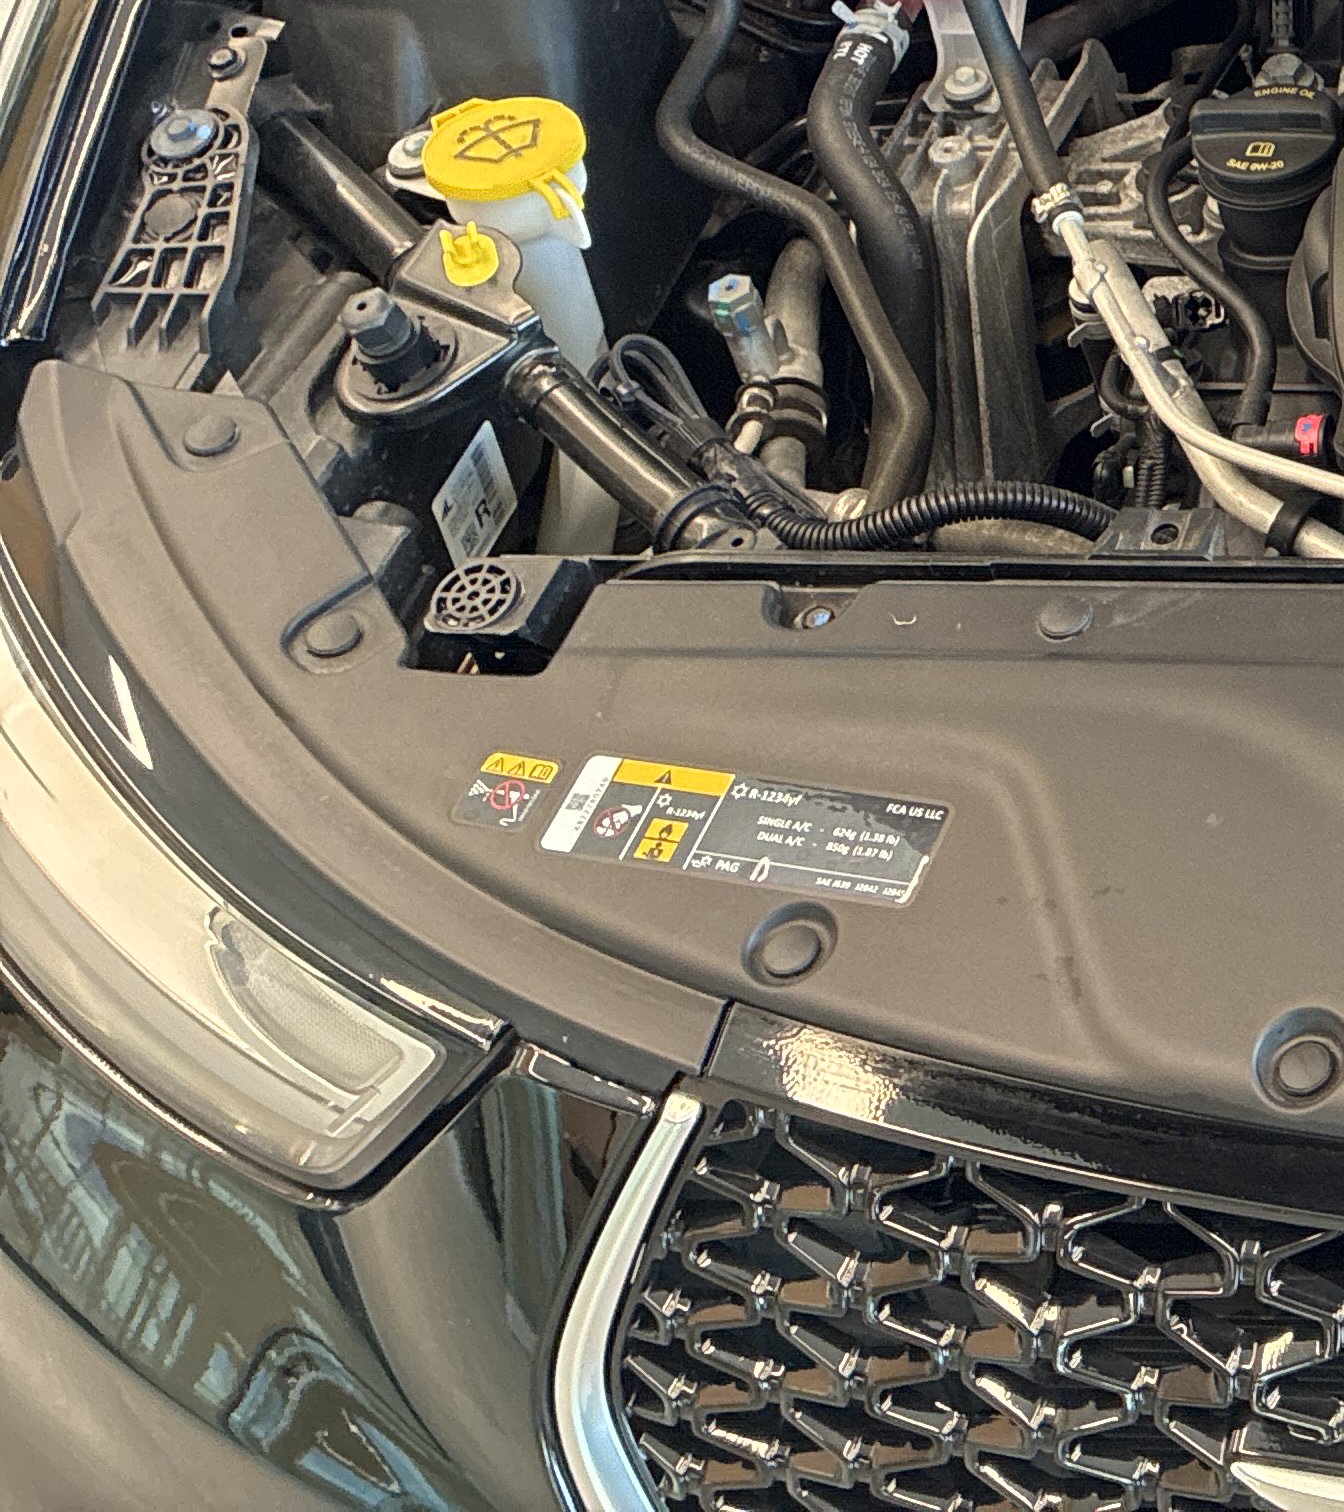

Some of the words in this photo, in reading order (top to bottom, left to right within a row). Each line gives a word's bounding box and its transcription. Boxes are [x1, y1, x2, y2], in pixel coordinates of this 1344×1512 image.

[850, 42, 873, 65] HOT
[1254, 87, 1298, 98] ENGINE
[1299, 89, 1316, 100] OIL
[1226, 158, 1247, 170] SAE
[1250, 160, 1285, 171] 0W-20
[748, 787, 803, 807] R-1234yf
[886, 803, 907, 815] FCA
[908, 806, 924, 818] US
[924, 808, 945, 820] LLC
[757, 815, 792, 830] SINGLE
[791, 820, 813, 833] A/C
[756, 831, 783, 844] DUAL
[784, 835, 806, 847] A/C
[715, 859, 741, 873] PAG
[815, 876, 833, 887] SAE
